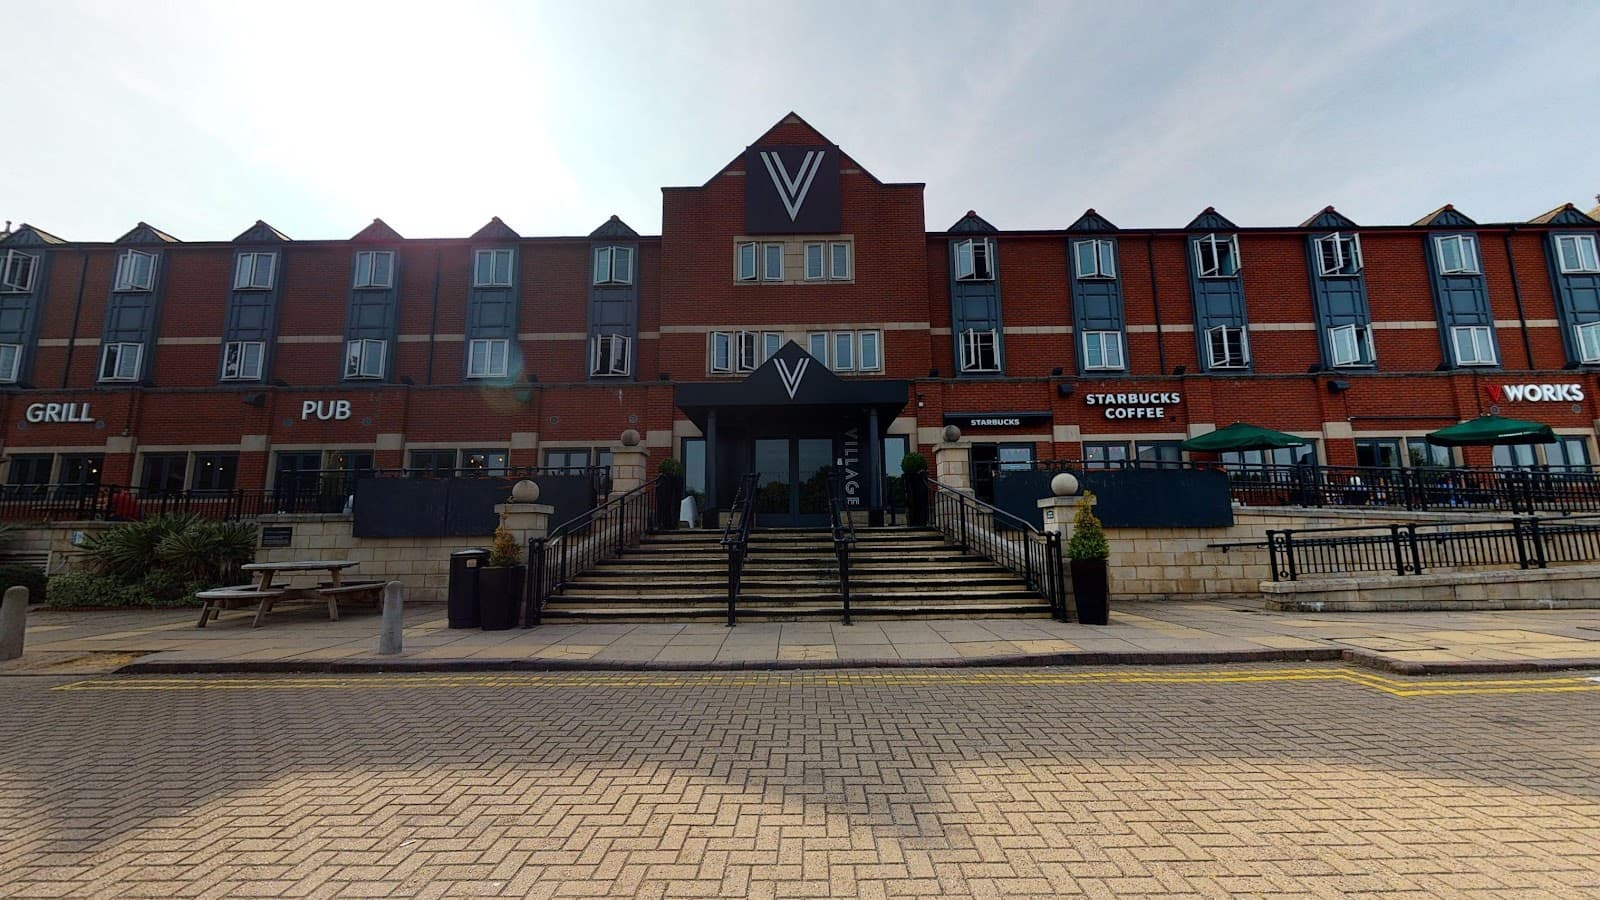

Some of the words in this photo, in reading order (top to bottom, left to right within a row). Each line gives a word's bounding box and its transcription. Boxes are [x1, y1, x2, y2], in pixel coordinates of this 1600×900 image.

[760, 150, 825, 223] V
[1086, 392, 1181, 405] STARBUCKS
[26, 402, 95, 423] GRILL
[301, 400, 352, 421] PUB
[1104, 406, 1165, 420] COFFEE
[970, 418, 1021, 426] STARBUCKS
[844, 427, 860, 505] VILLAGE
